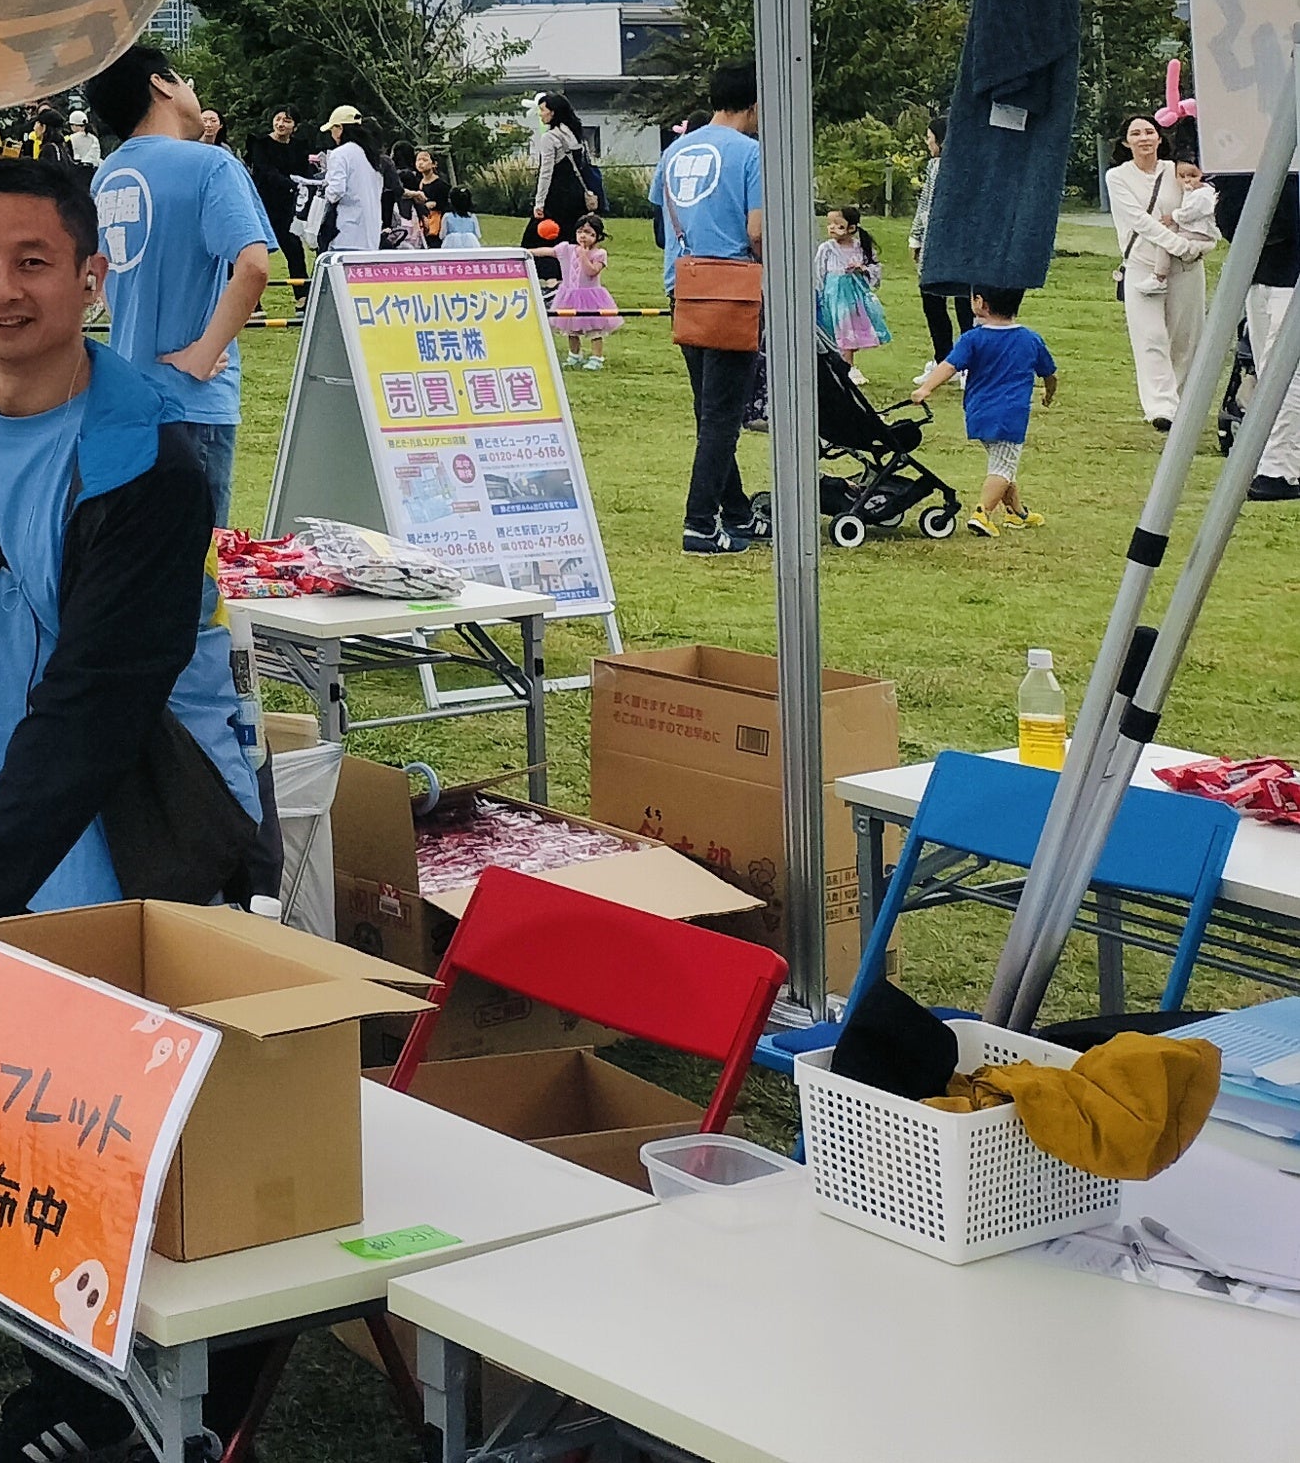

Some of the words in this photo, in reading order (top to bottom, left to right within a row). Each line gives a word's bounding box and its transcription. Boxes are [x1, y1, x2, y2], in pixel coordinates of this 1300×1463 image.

[353, 288, 529, 326] ロイヤルハウジング
[415, 327, 488, 363] 販売株
[384, 371, 539, 414] 売買・賃貸
[489, 445, 566, 463] 0120-40-6186
[427, 540, 495, 558] 20-08-6186
[510, 533, 586, 551] 0120-47-6186
